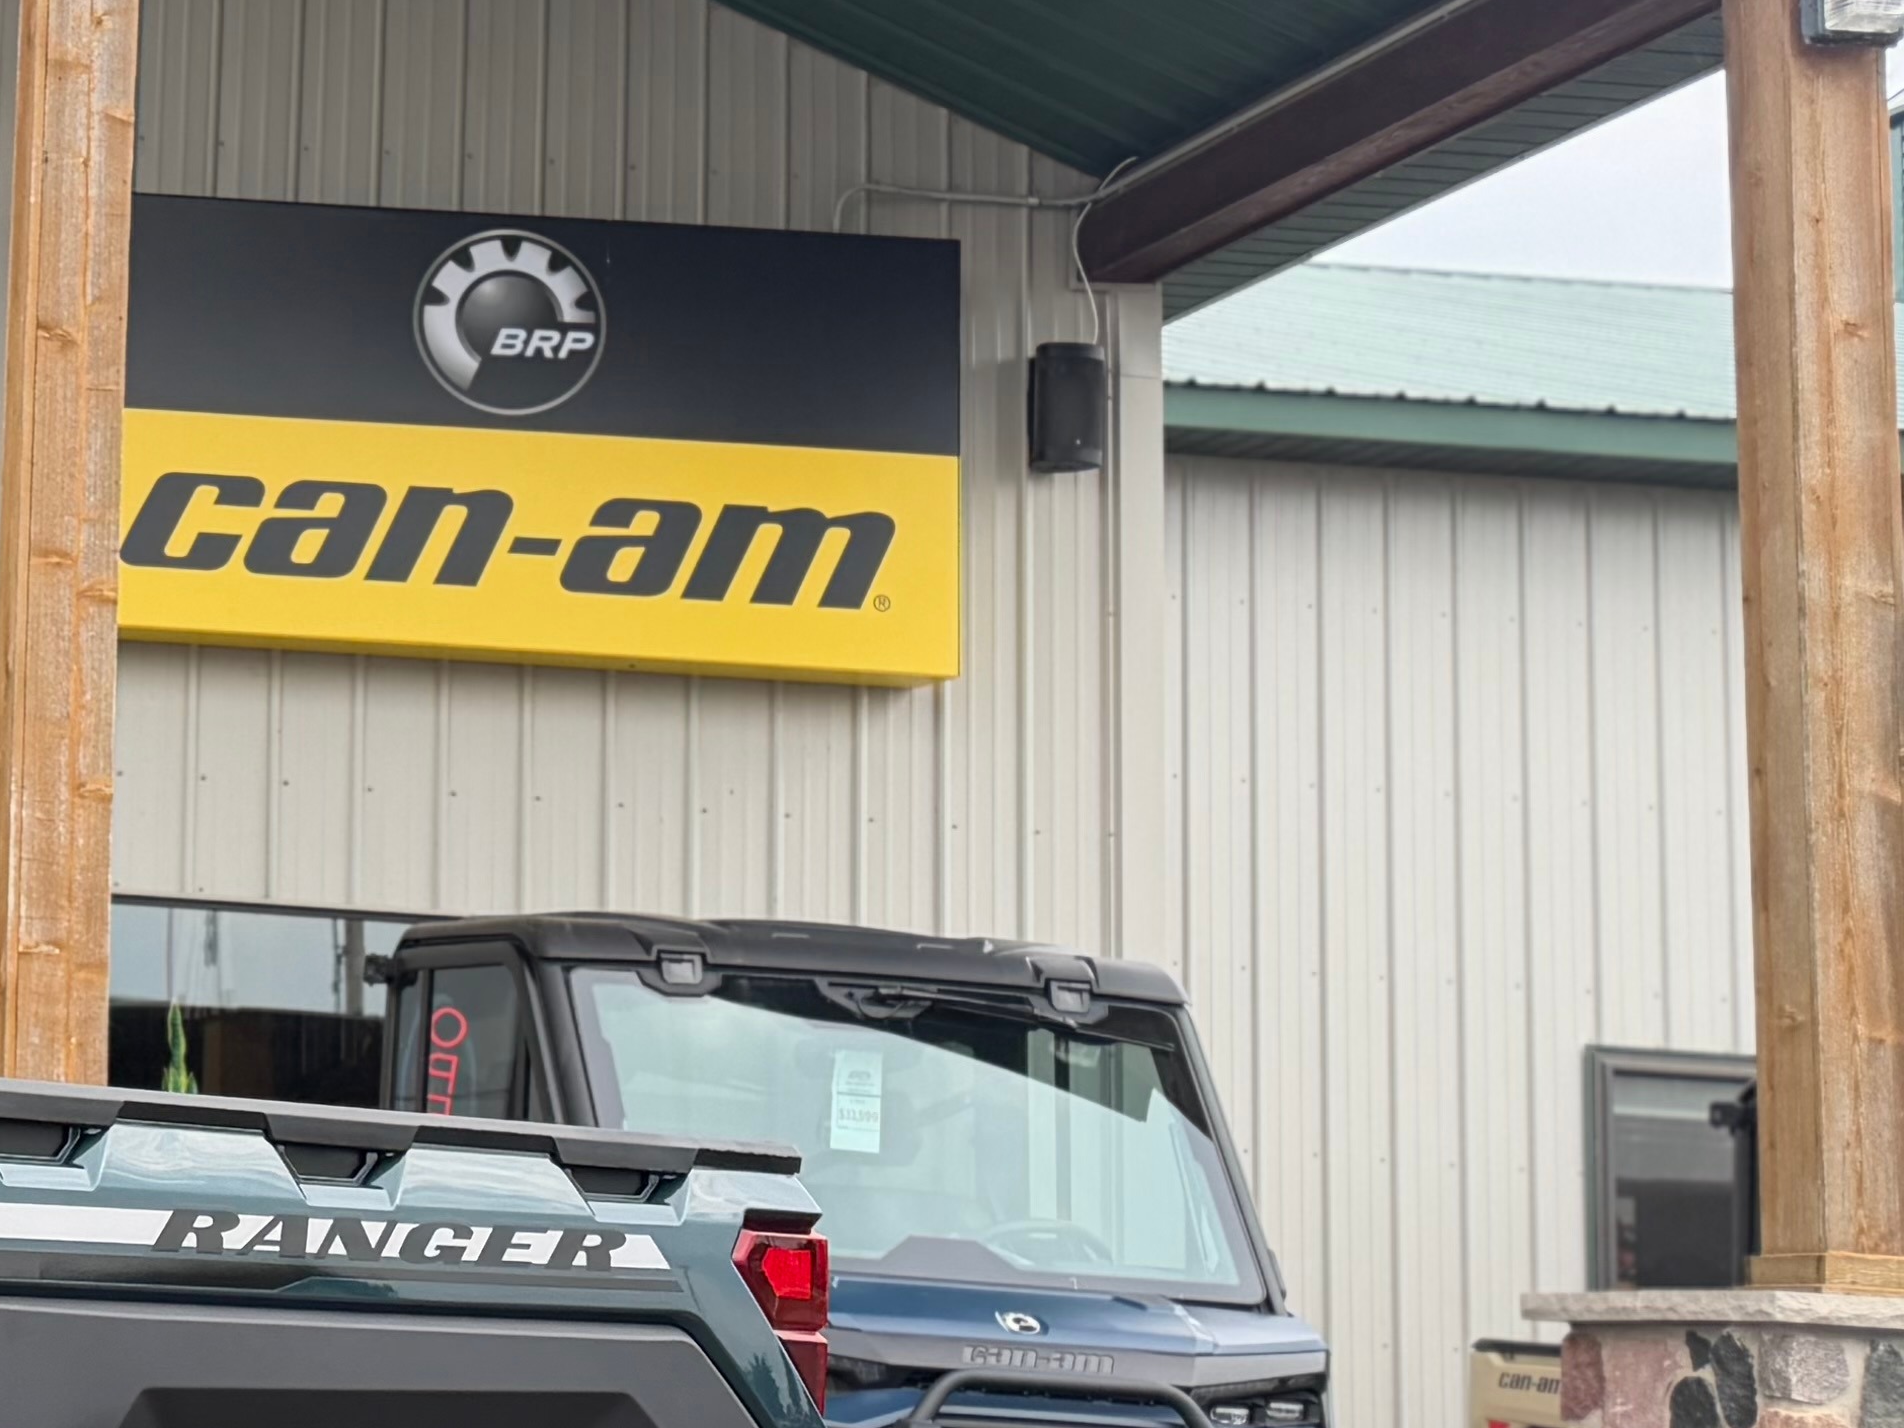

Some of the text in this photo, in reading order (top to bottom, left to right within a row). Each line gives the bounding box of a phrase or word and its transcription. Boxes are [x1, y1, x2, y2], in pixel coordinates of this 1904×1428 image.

[490, 327, 595, 359] BRP
[119, 470, 897, 611] can-am
[150, 1207, 628, 1272] RANGER
